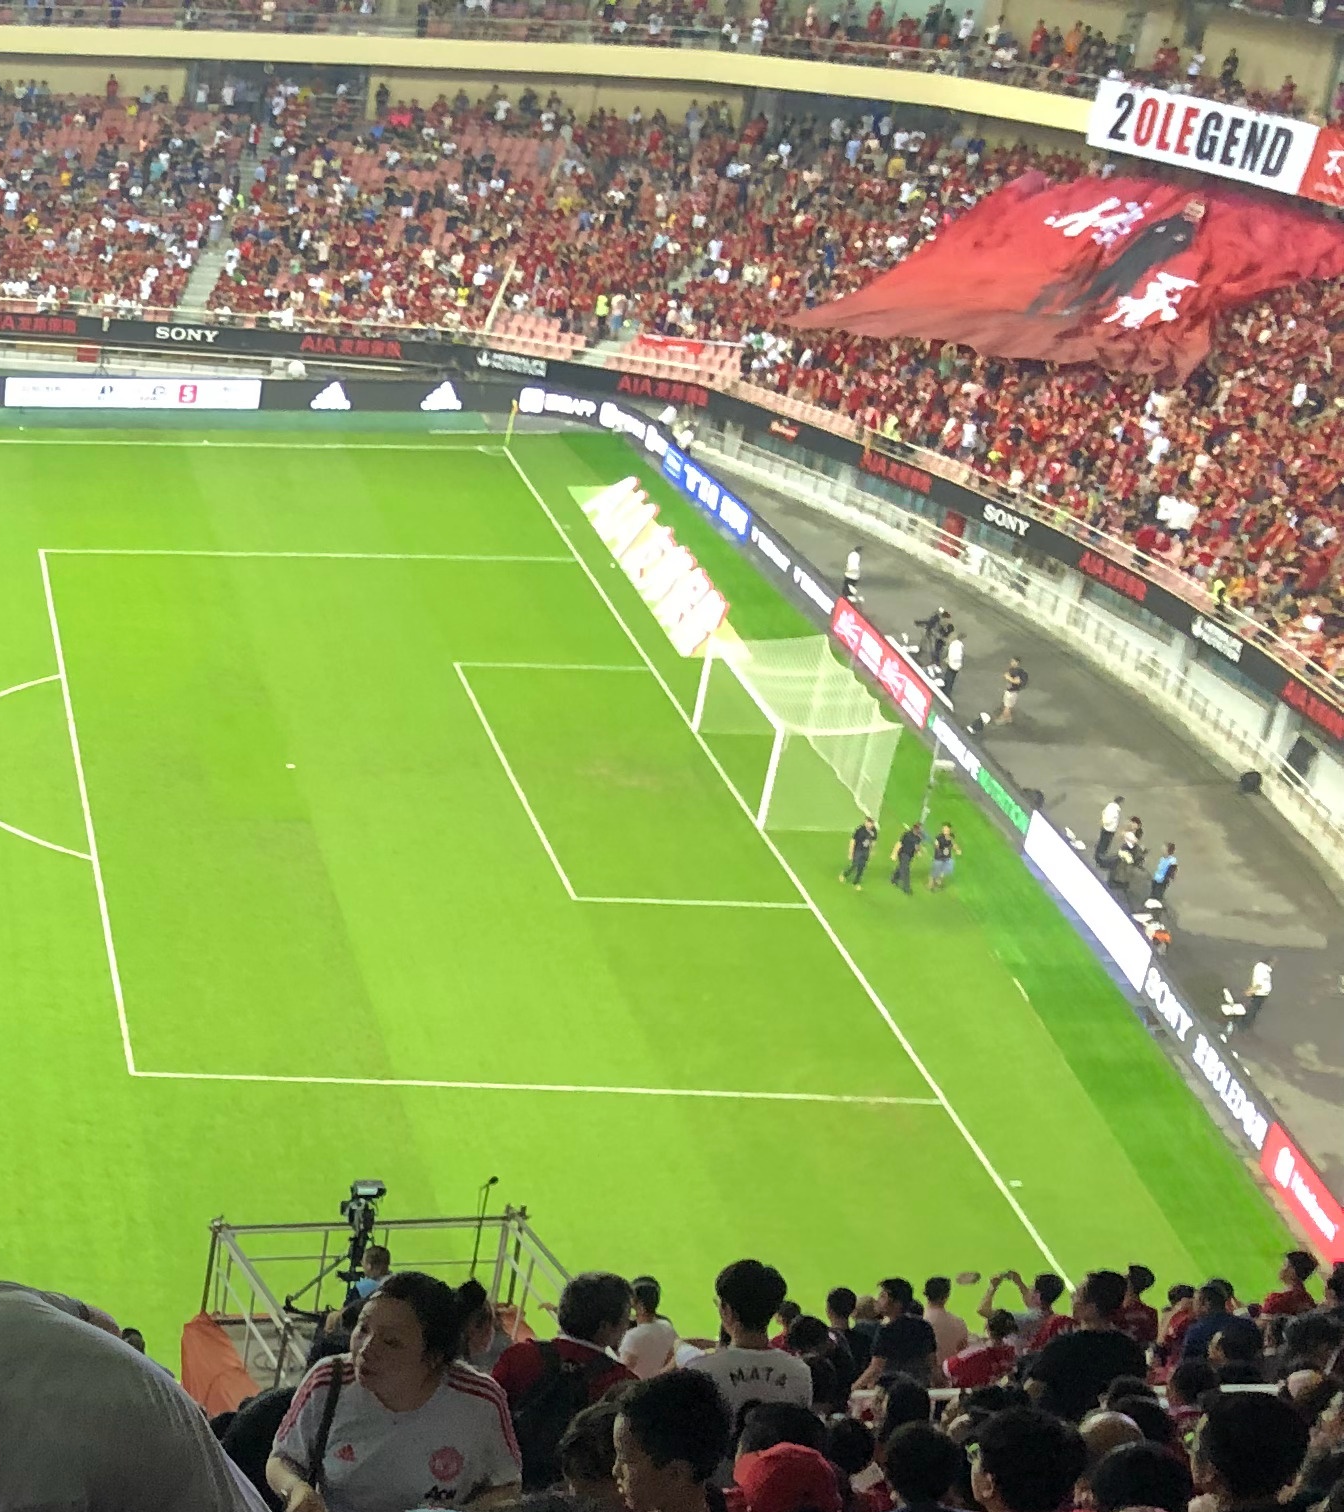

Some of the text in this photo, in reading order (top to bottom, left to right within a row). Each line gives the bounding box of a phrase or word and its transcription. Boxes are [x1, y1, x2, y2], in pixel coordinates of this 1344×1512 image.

[155, 325, 219, 343] SONY
[983, 503, 1031, 537] SONY
[729, 1366, 788, 1388] MATA
